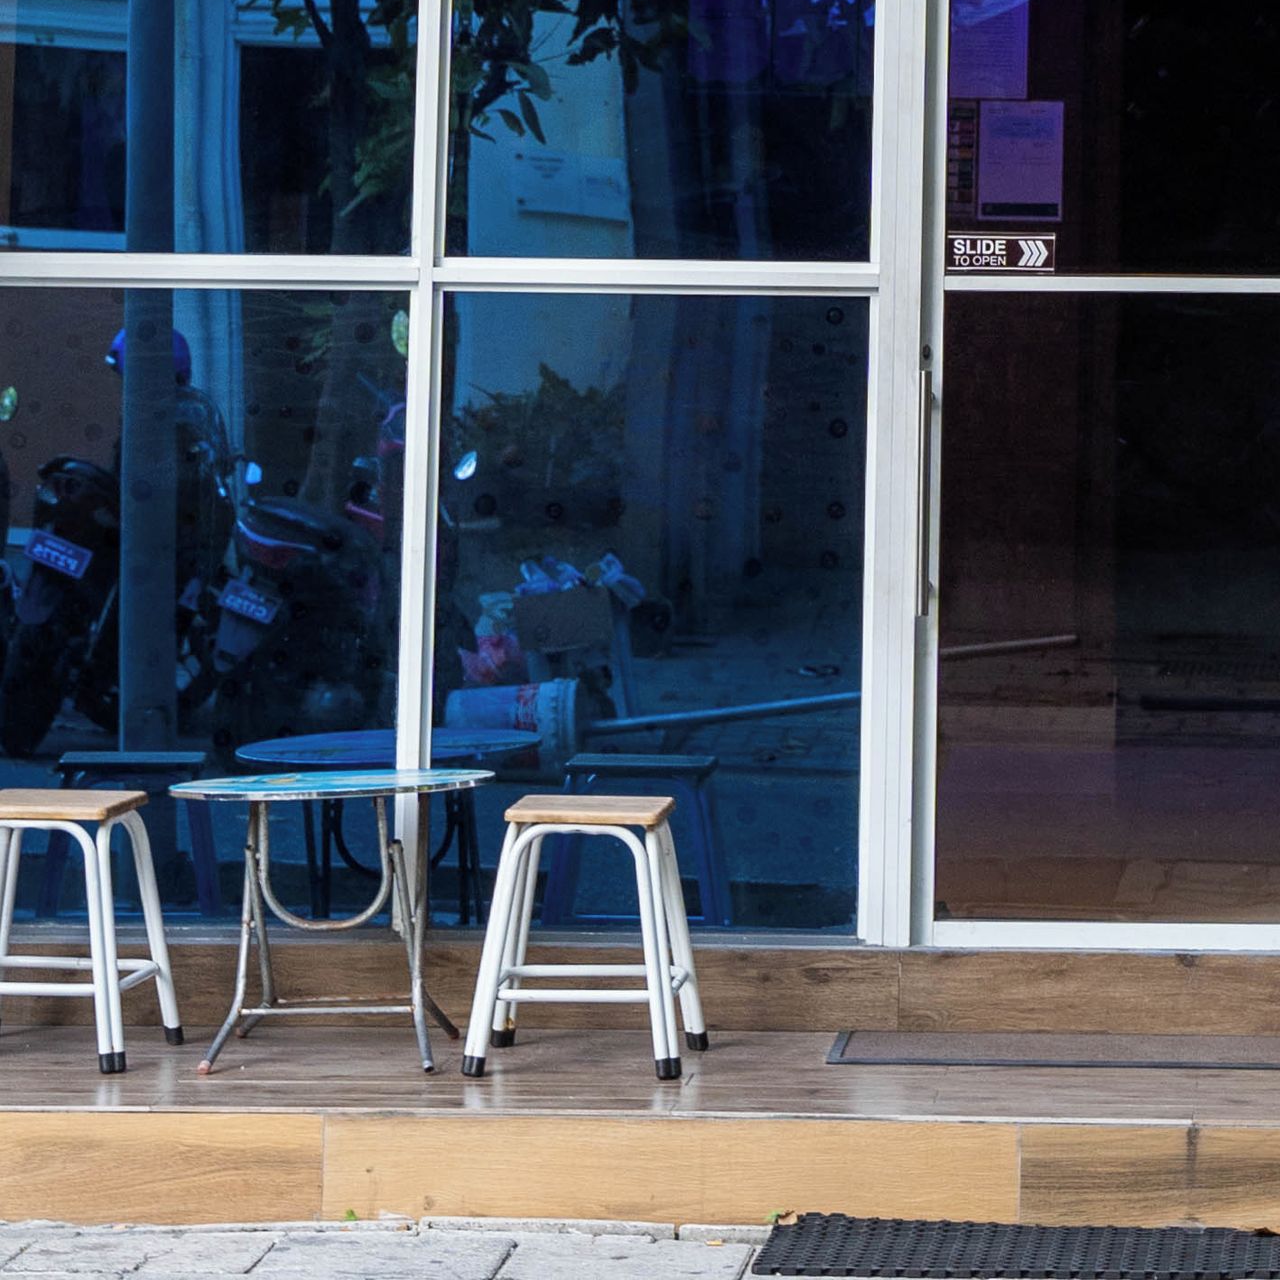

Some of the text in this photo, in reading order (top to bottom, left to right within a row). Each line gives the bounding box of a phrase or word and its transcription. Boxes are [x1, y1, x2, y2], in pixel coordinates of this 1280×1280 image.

[953, 239, 1006, 255] SLIDE
[954, 255, 1006, 267] TO OPEN
